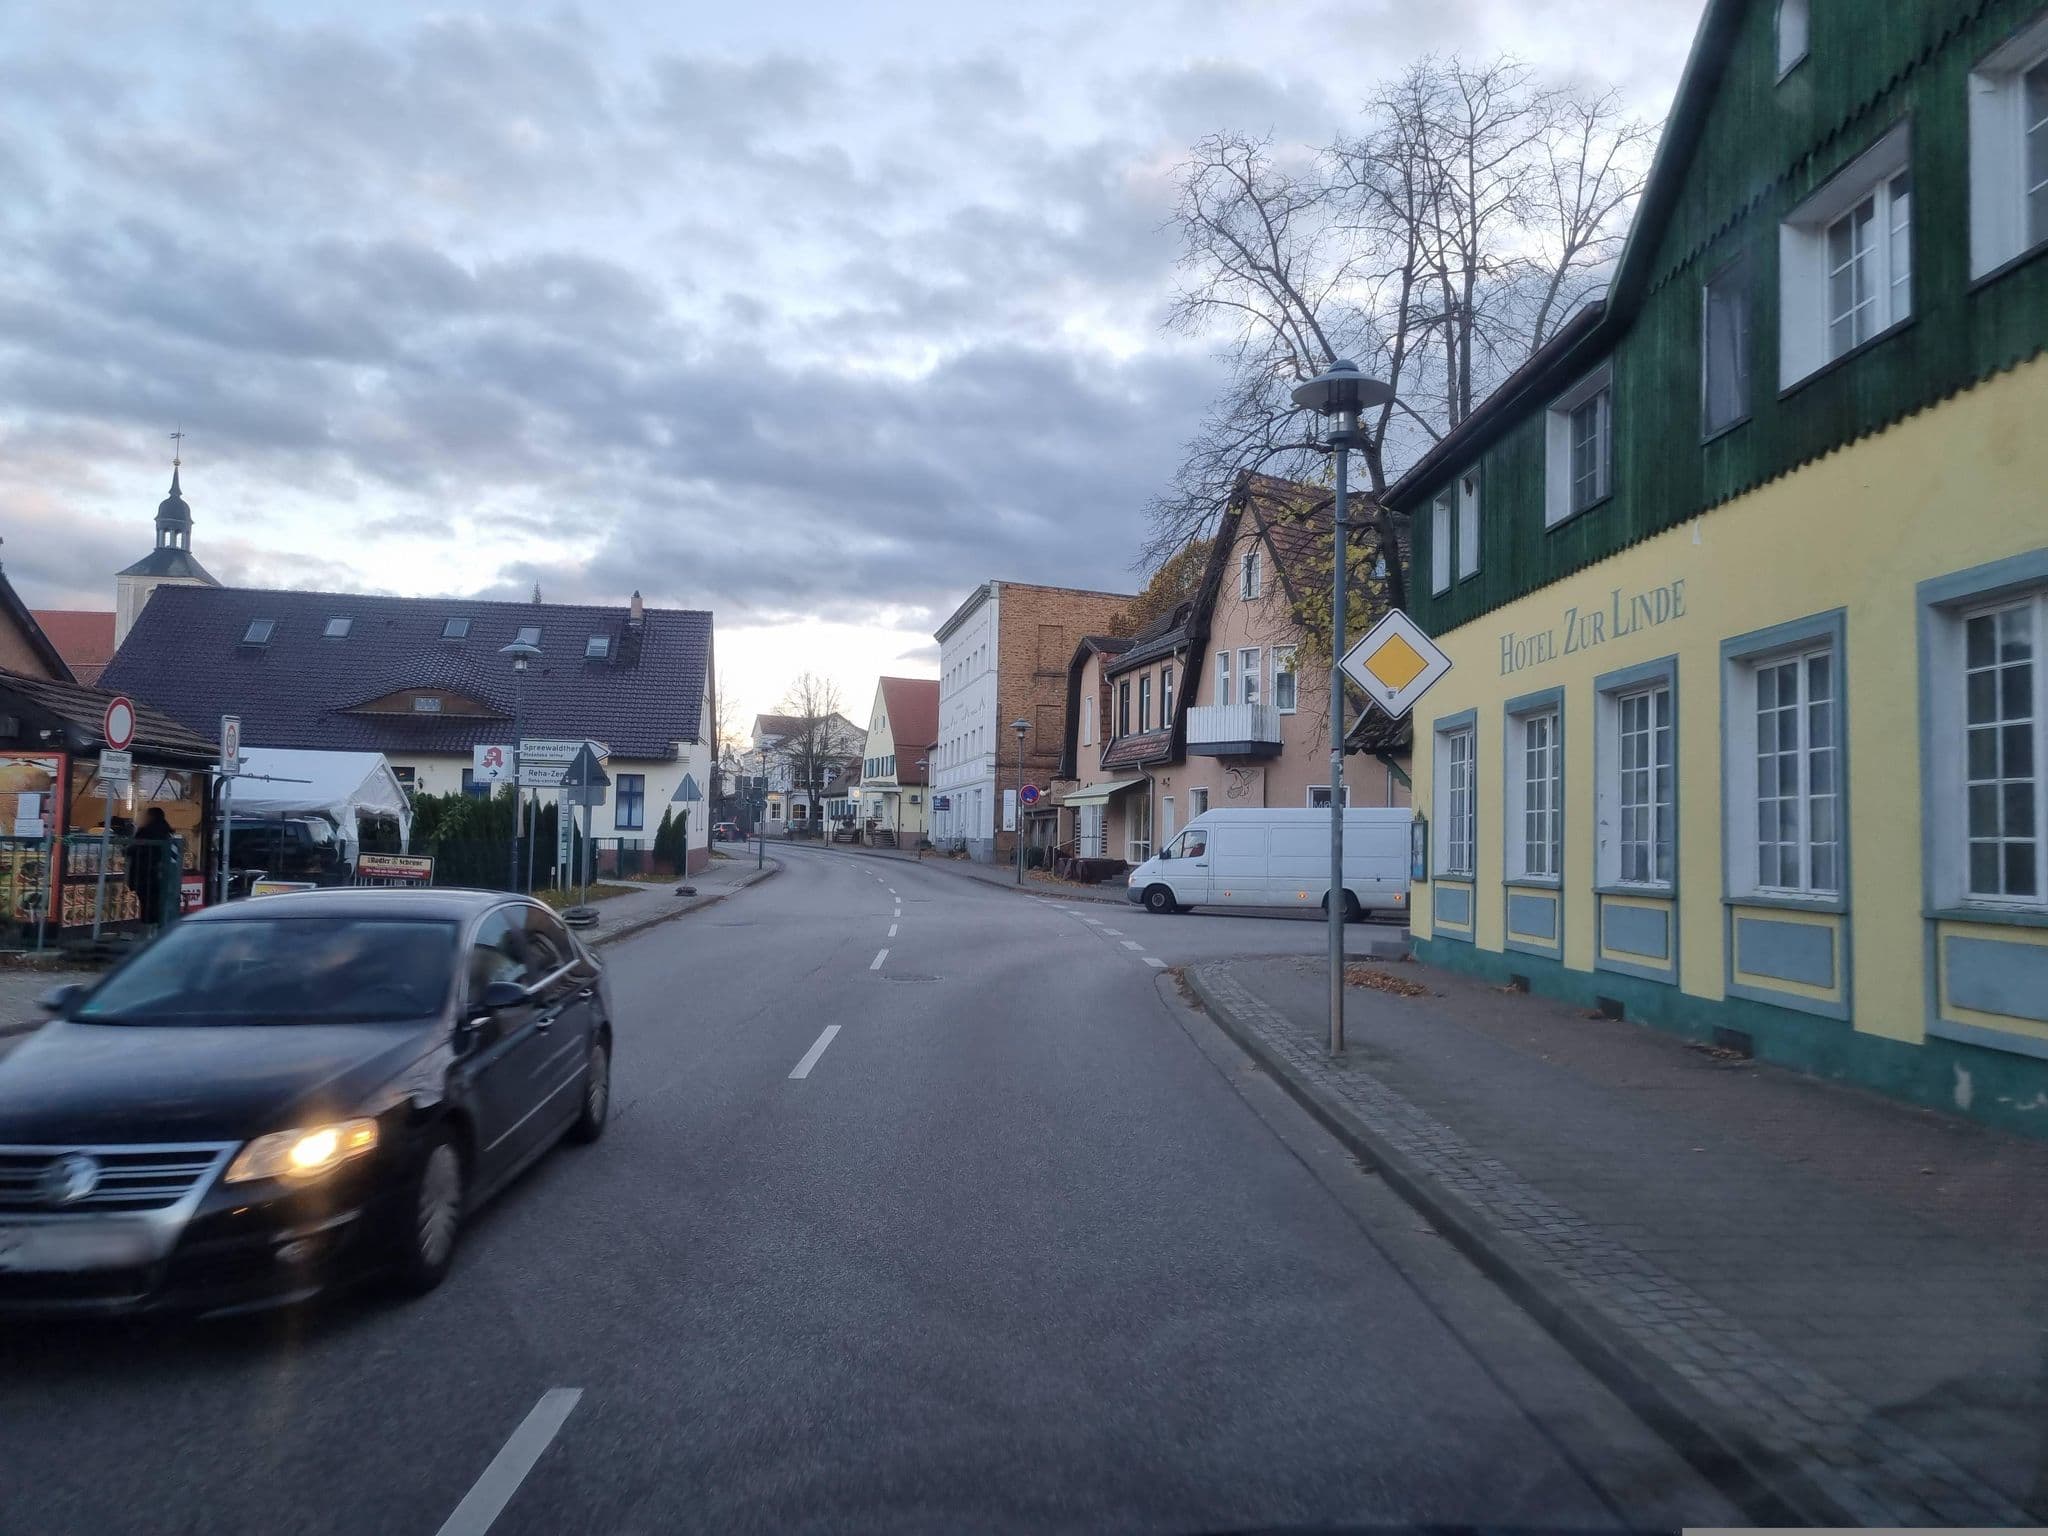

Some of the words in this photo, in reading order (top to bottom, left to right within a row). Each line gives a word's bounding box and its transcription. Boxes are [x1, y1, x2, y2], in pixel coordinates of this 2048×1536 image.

[1500, 630, 1558, 676] HOTEL
[1563, 606, 1606, 656] ZUR
[1611, 578, 1687, 639] LINDE
[523, 743, 578, 752] Spreewaldther
[528, 769, 566, 777] Reha-Zen
